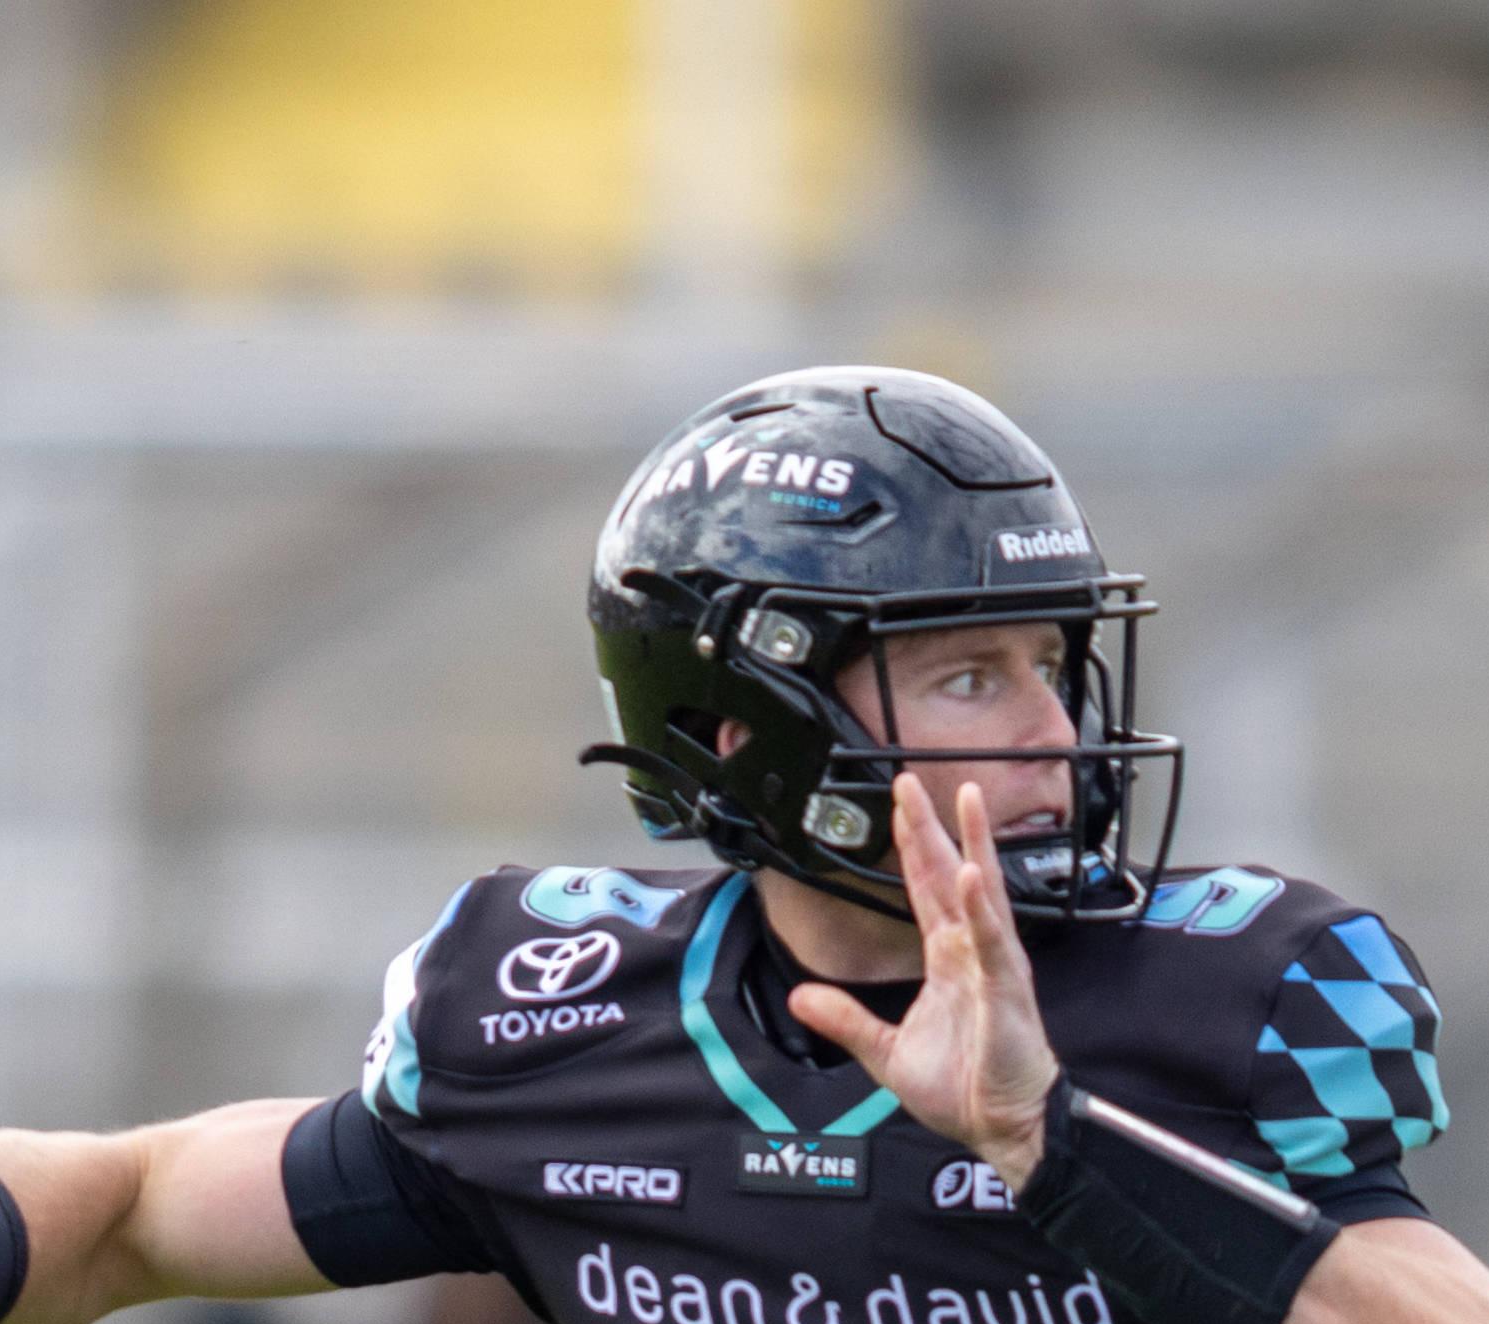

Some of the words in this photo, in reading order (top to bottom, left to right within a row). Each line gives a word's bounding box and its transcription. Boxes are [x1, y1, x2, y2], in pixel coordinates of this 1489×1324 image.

[998, 528, 1091, 562] Riddell
[480, 1002, 625, 1045] TOYOTA
[744, 1142, 856, 1178] RAVENS
[544, 1162, 680, 1201] KPRO
